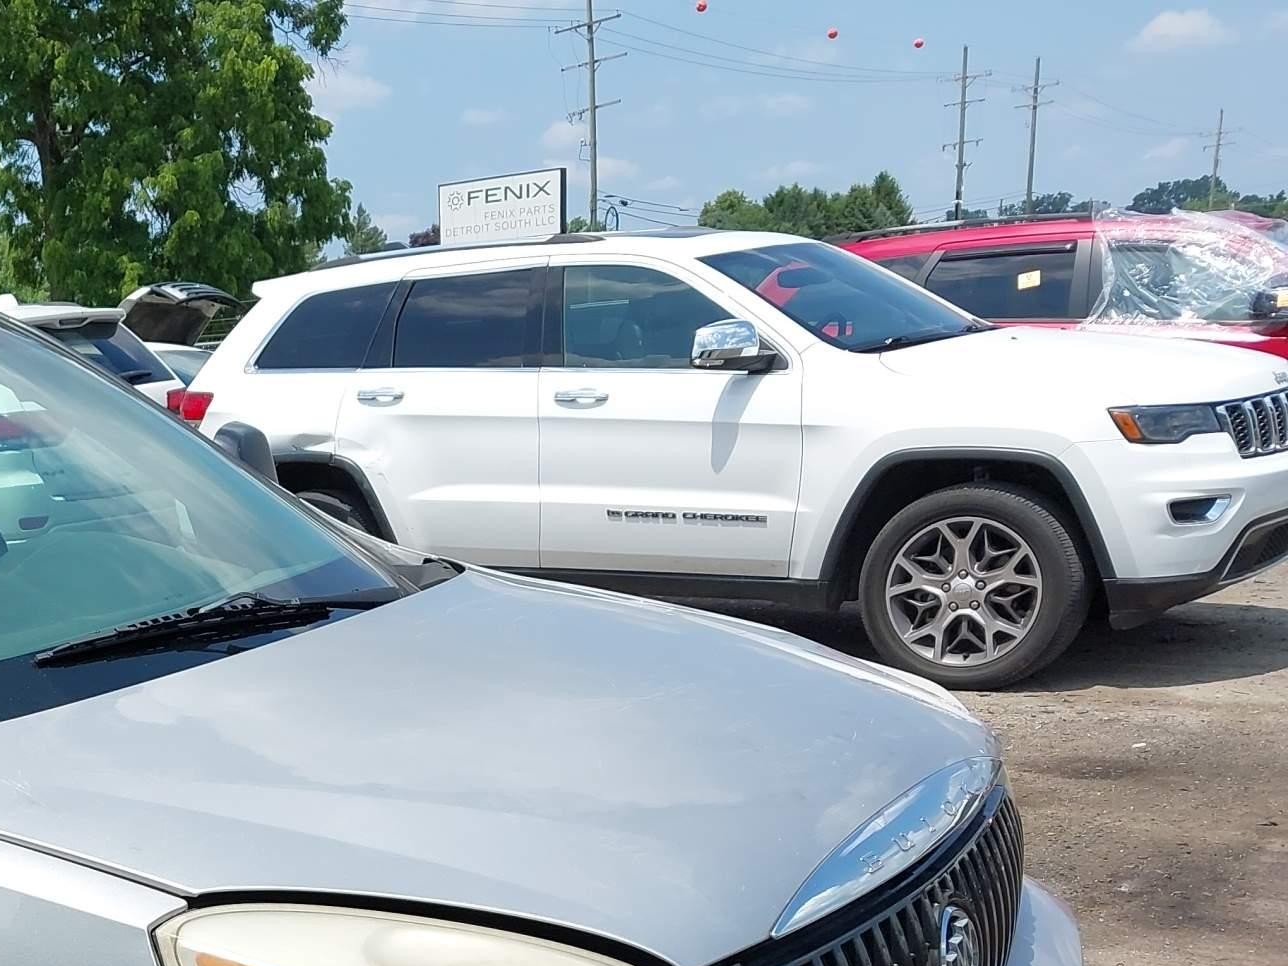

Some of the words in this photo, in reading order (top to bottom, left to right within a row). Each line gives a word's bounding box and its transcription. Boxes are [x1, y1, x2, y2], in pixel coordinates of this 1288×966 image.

[467, 180, 551, 206] FENIX
[484, 208, 516, 221] FENIX
[519, 203, 556, 216] PARTS
[445, 222, 491, 238] DETROIT
[494, 219, 532, 232] SOUTH
[535, 215, 556, 227] LLC
[682, 511, 768, 523] CHEROKEE
